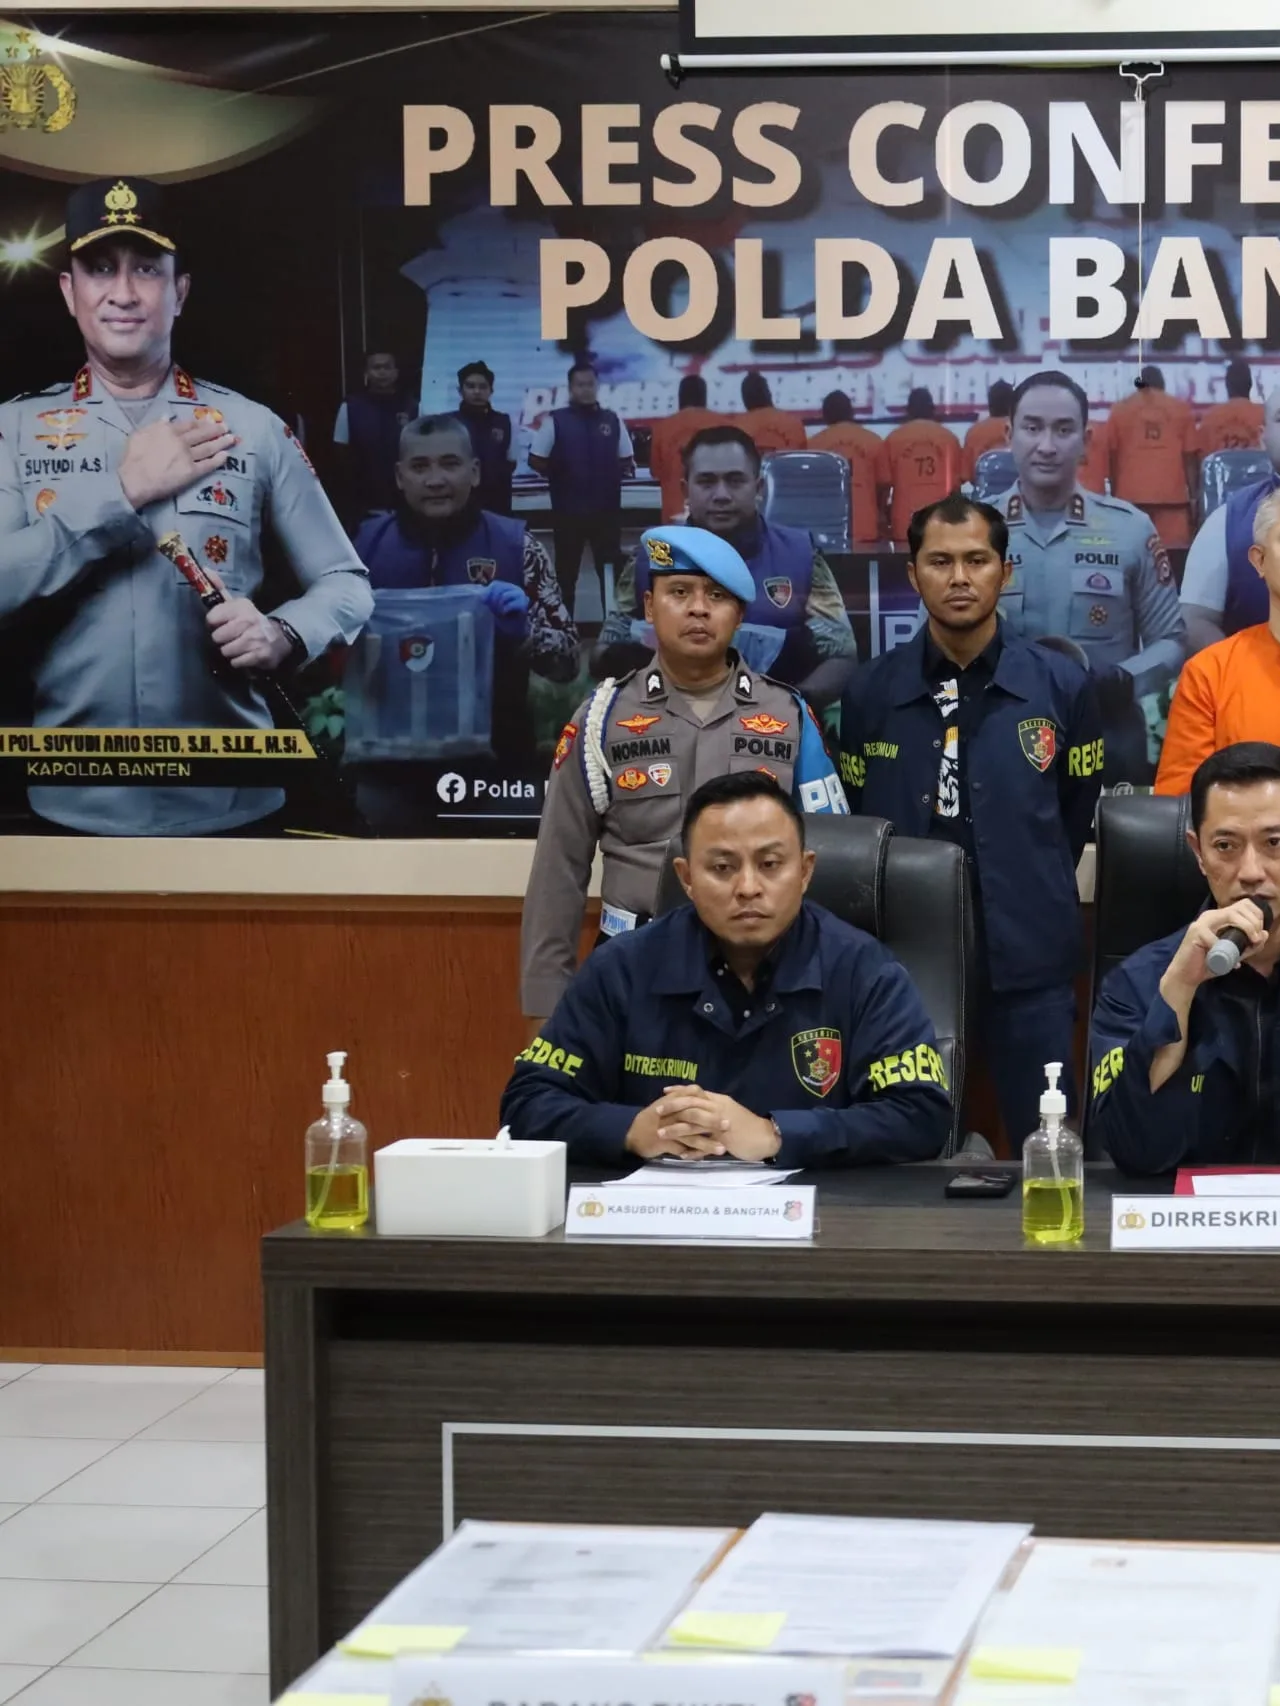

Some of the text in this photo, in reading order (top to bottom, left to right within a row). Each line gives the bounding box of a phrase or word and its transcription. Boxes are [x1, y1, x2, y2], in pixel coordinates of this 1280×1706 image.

[403, 101, 801, 207] PRESS
[540, 236, 1004, 342] POLDA
[25, 458, 74, 476] SUYUDI
[1075, 553, 1119, 566] POLRI
[44, 735, 101, 753] SUYUDI
[104, 735, 140, 753] ARIO
[611, 738, 671, 762] NORMAN
[734, 737, 792, 760] POLRI
[27, 763, 191, 777] KAPOLDA BANTEN
[474, 780, 536, 798] Polda
[608, 1206, 780, 1217] KASUBDIT HARDA & BANGTAH
